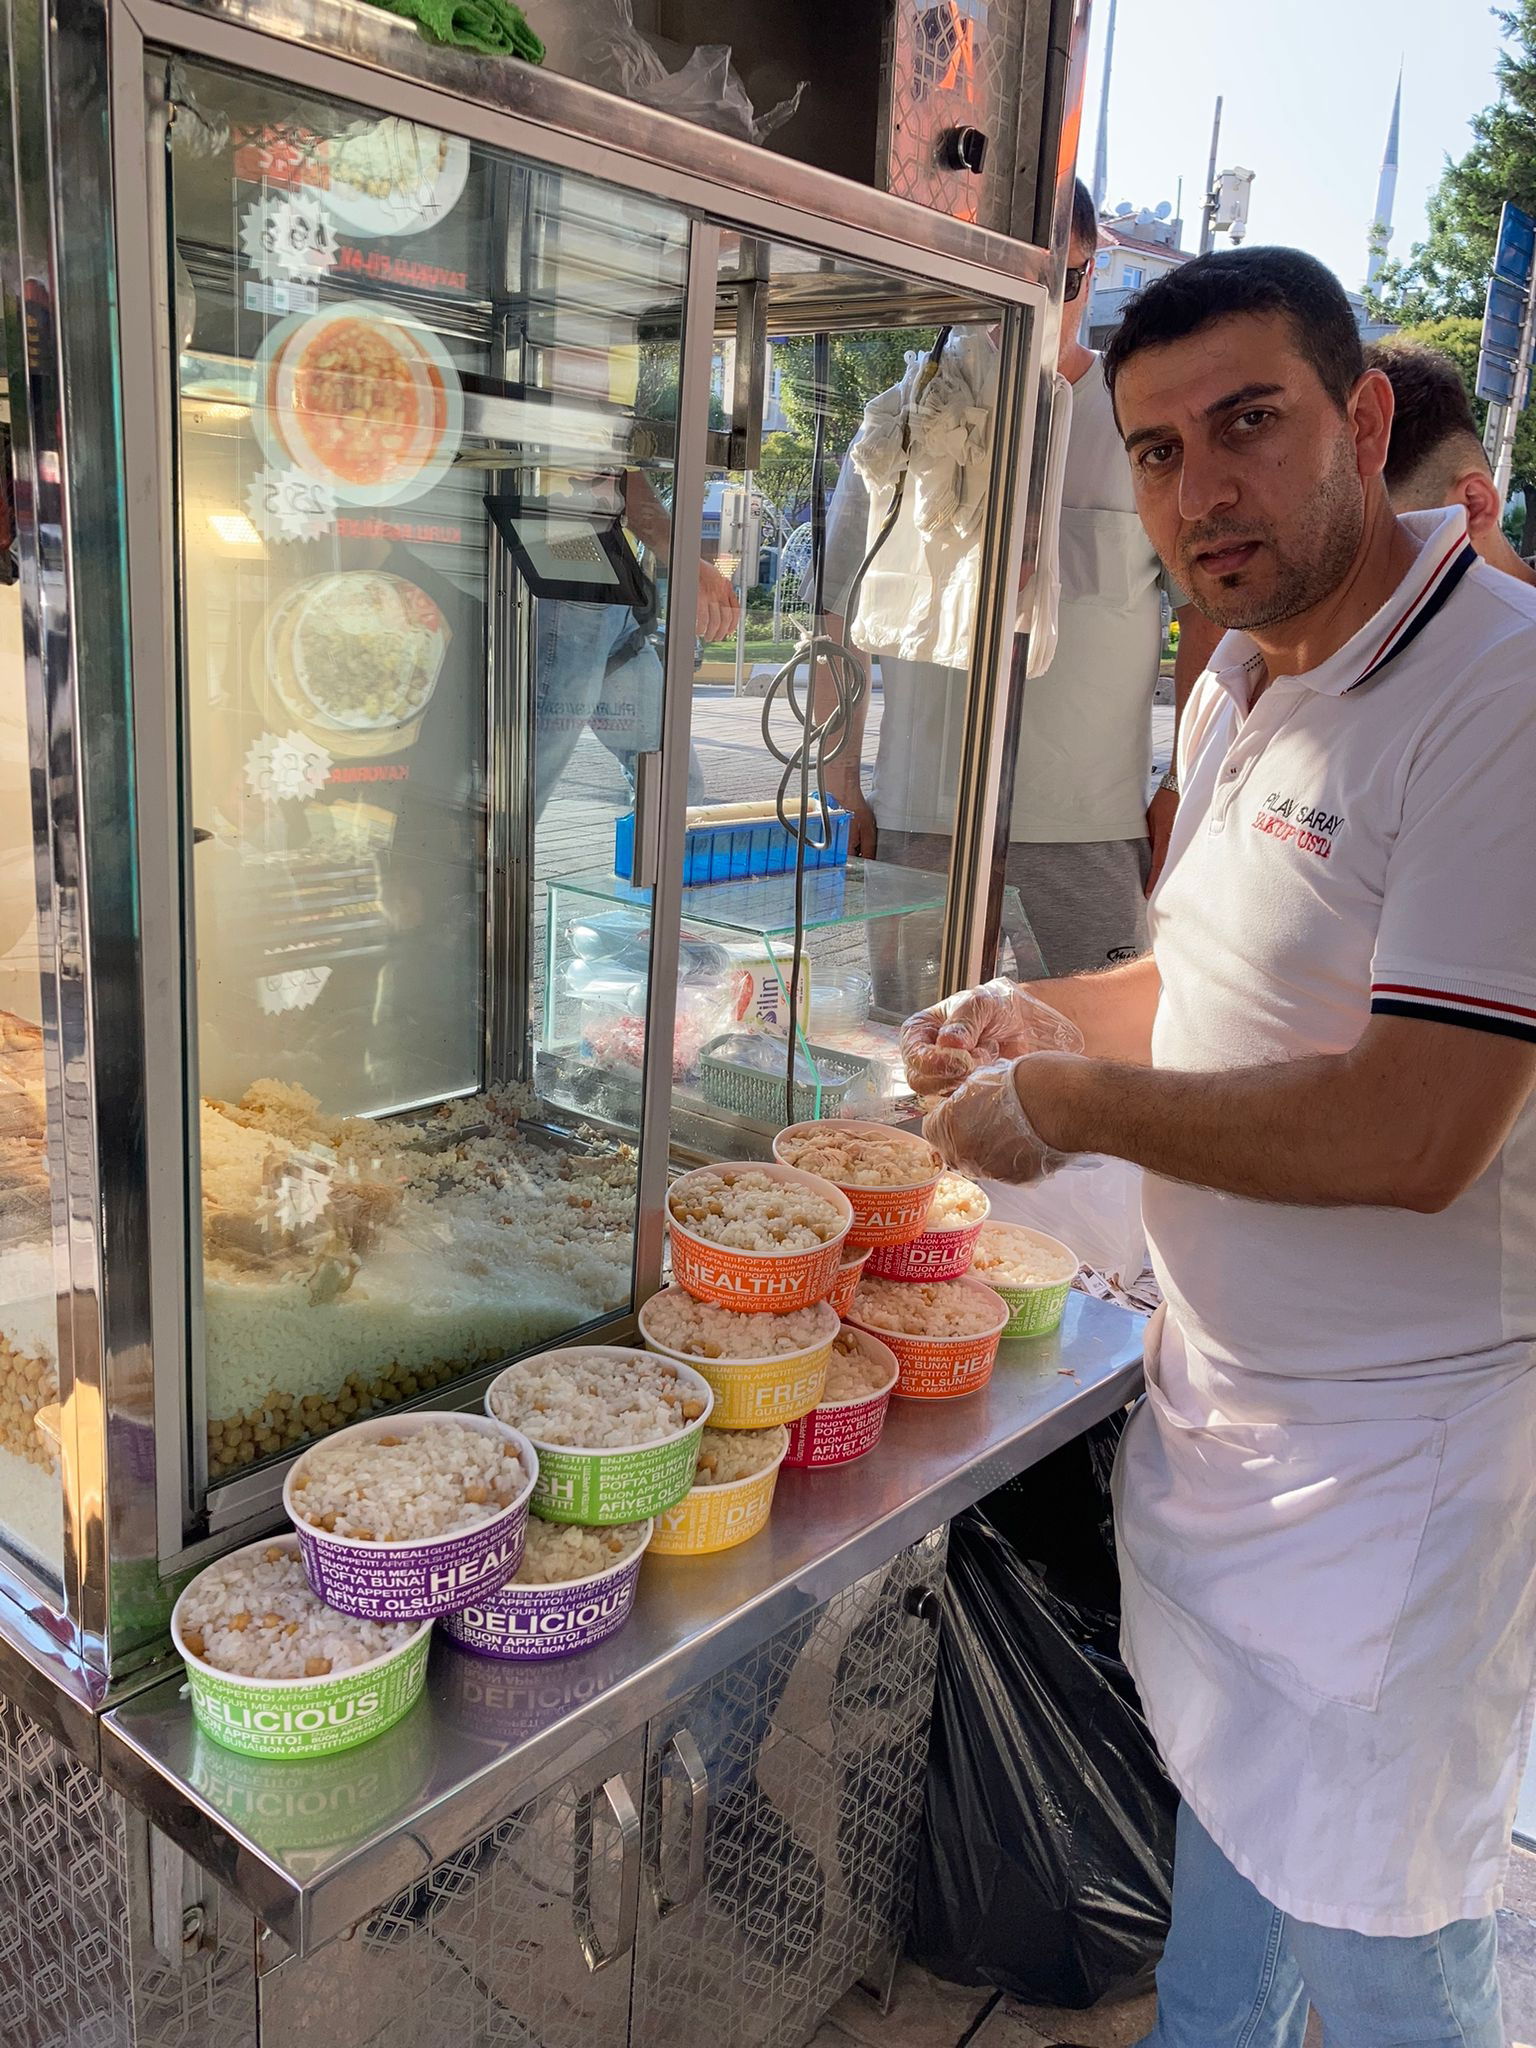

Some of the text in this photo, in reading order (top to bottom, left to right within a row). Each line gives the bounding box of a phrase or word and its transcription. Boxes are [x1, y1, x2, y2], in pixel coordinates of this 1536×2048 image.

[1252, 811, 1297, 841] YAKUP
[737, 1257, 773, 1267] POFTA
[775, 1255, 806, 1266] BUNA!
[748, 1265, 774, 1273] ENJOY
[775, 1264, 796, 1272] YOUR
[906, 1265, 935, 1273] BUON
[685, 1257, 806, 1295] HEALTHY
[745, 1272, 777, 1280] POFTA
[779, 1268, 808, 1279] BUNA!
[905, 1271, 933, 1279] POFTA
[905, 1340, 930, 1348] YOUR
[901, 1369, 950, 1377] APPETITO!
[914, 1361, 952, 1370] BUNA!
[756, 1367, 828, 1408] FRESH
[901, 1384, 925, 1392] YOUR
[921, 1376, 967, 1387] OLSUN!
[755, 1404, 793, 1417] GUTEN
[814, 1413, 867, 1429] ENJOY YOUR
[814, 1425, 854, 1437] POFTA
[812, 1440, 859, 1455] AFİYET
[813, 1436, 842, 1445] BUON
[600, 1445, 669, 1465] ENJOY YOUR
[811, 1453, 841, 1462] ENJOY
[599, 1464, 622, 1473] BON
[600, 1471, 636, 1482] ENJOY
[638, 1462, 665, 1476] YOUR
[600, 1458, 687, 1491] POFTA BUNA!
[598, 1493, 655, 1512] AFİYET
[599, 1489, 634, 1501] BUON
[598, 1501, 662, 1521] ENJOY YOUR
[315, 1537, 348, 1555] ENJOY
[350, 1549, 386, 1559] YOUR
[388, 1547, 429, 1560] MEAL!
[429, 1540, 466, 1557] GUTEN
[317, 1546, 335, 1560] BON
[335, 1553, 379, 1568] APPETIT!
[417, 1551, 457, 1566] OLSUN!
[457, 1538, 489, 1557] POFTA
[318, 1555, 350, 1573] ENJOY
[352, 1566, 387, 1577] YOUR
[388, 1566, 427, 1578] MEAL!
[429, 1556, 470, 1574] GUTEN
[320, 1563, 425, 1589] POFTA BUNA!
[322, 1575, 425, 1599] BUON APPETITO!
[325, 1585, 381, 1610] AFİYET
[384, 1590, 456, 1611] OLSUN!
[326, 1596, 357, 1614] ENJOY
[359, 1607, 393, 1618] YOUR
[394, 1607, 431, 1619] MEAL!
[431, 1598, 465, 1614] GUTEN
[498, 1595, 564, 1607] APPETITO!
[502, 1593, 607, 1616] YOUR MEAL! GUTEN
[463, 1582, 632, 1635] DELICIOUS
[464, 1627, 502, 1645] BUON
[505, 1630, 580, 1647] APPETITO!
[464, 1629, 607, 1655] POFTA BUNA! BON APPETIT!
[212, 1682, 275, 1703] APPETITO!
[324, 1677, 369, 1698] OLSUN!
[371, 1659, 408, 1681] GUTEN
[192, 1683, 380, 1733] DELICIOUS
[218, 1694, 249, 1710] YOUR
[251, 1702, 291, 1712] MEAL!
[291, 1700, 333, 1713] GUTEN
[222, 1733, 260, 1751] BUNA!
[259, 1744, 286, 1754] BON
[288, 1737, 342, 1754] APPETIT!
[223, 1726, 303, 1746] APPETITO!
